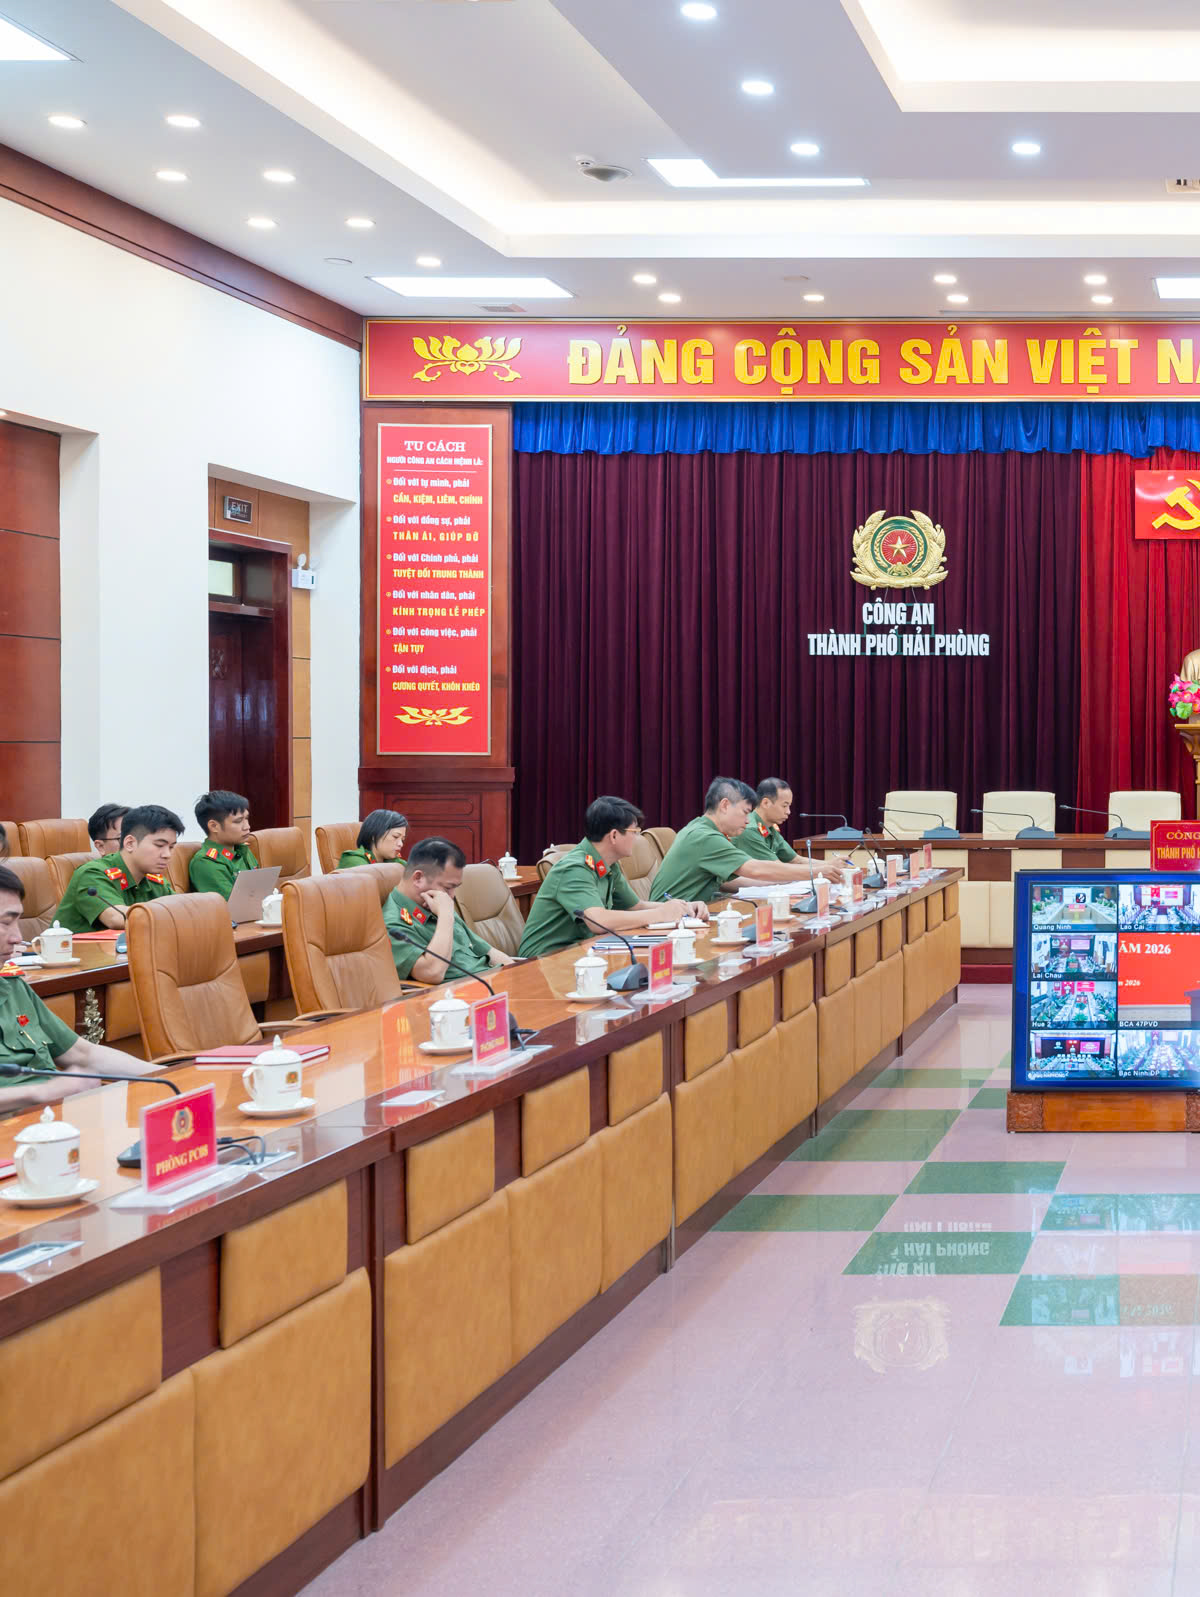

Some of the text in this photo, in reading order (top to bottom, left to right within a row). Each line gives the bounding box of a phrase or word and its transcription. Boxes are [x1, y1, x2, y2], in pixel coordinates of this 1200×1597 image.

[567, 324, 714, 386] ĐẢNG
[734, 328, 878, 395] CỘNG
[899, 324, 1010, 385] SẢN
[1027, 328, 1140, 394] VIỆT
[427, 440, 466, 452] CÁCH
[231, 502, 248, 513] EXIT
[862, 597, 934, 625] CÔNG AN
[807, 625, 990, 656] THÀNH PHỐ HẢI PHÒNG
[1145, 944, 1171, 954] 2026
